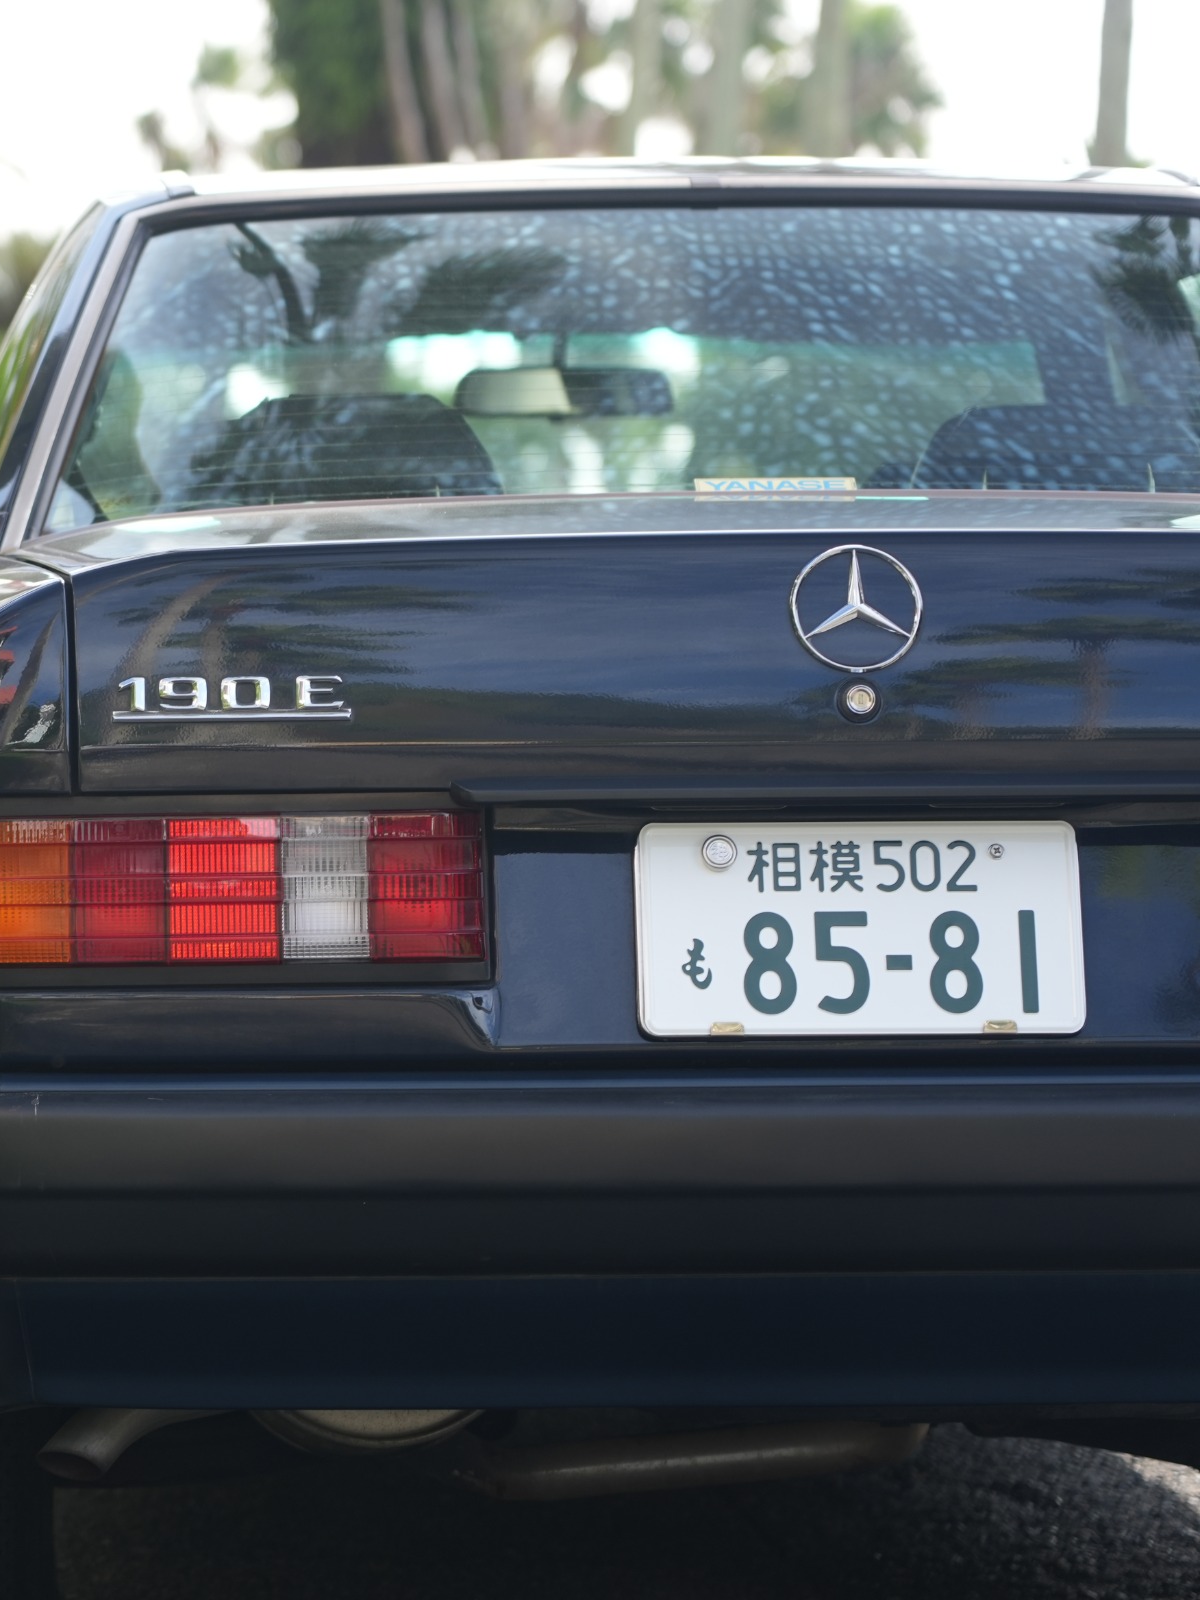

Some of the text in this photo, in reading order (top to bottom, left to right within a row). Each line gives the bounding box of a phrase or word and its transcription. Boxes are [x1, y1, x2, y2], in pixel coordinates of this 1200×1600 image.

[705, 480, 845, 490] YANASE
[118, 675, 345, 711] 190 E
[743, 908, 1040, 1014] 85-81
